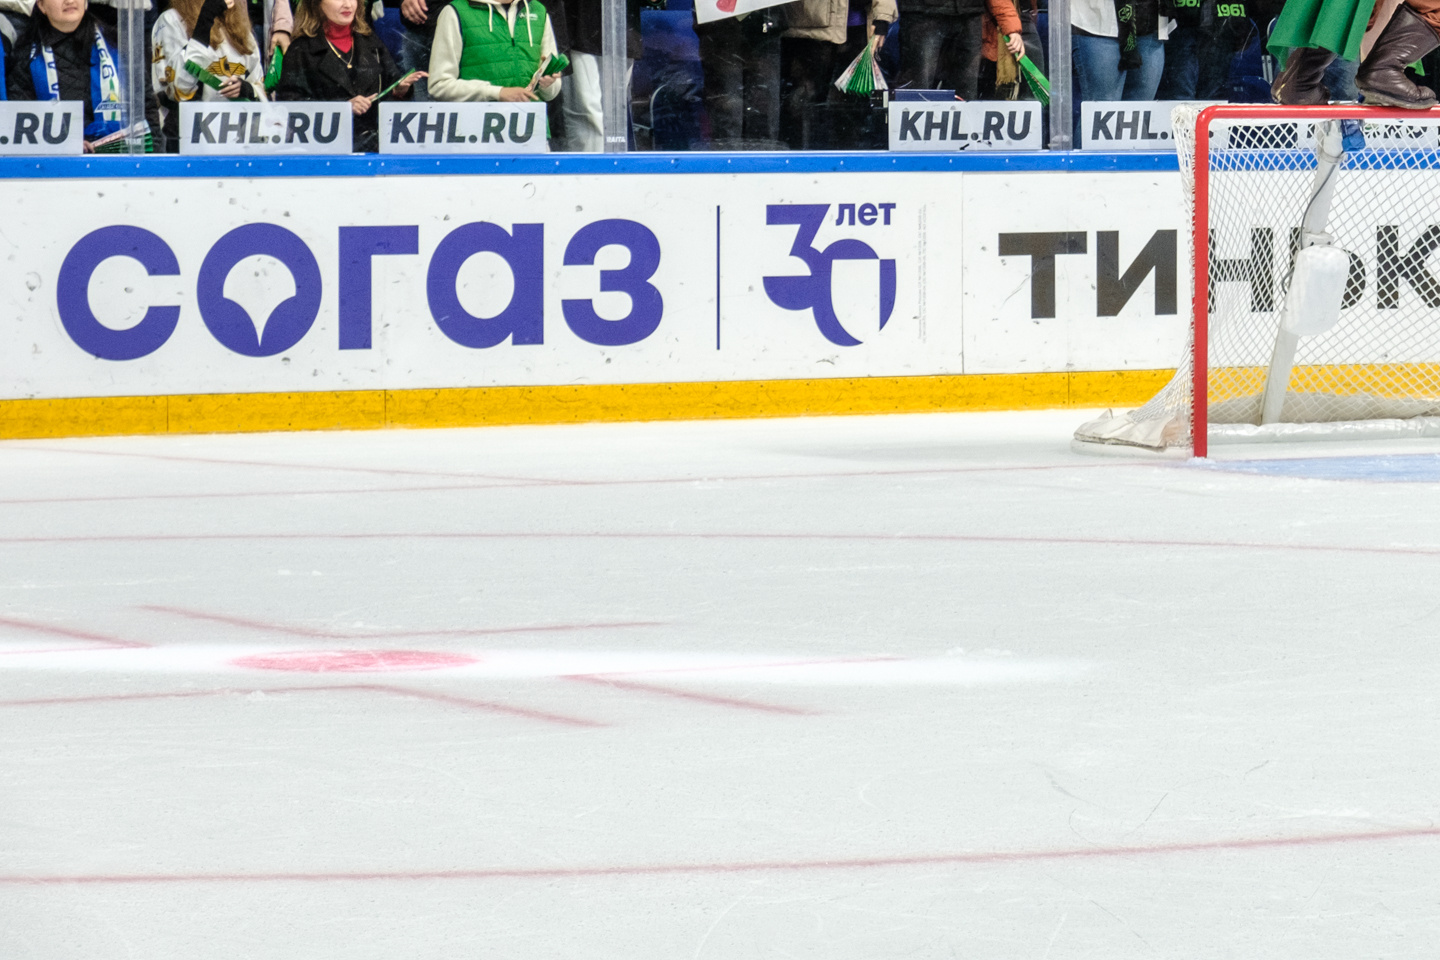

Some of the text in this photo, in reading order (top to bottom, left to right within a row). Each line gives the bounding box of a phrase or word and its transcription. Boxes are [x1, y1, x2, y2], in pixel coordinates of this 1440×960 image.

[1216, 3, 1247, 18] 1961
[190, 111, 341, 145] KHL.RU
[390, 111, 537, 145] KHL.RU
[899, 110, 1033, 143] KHL.RU
[835, 202, 897, 227] лет
